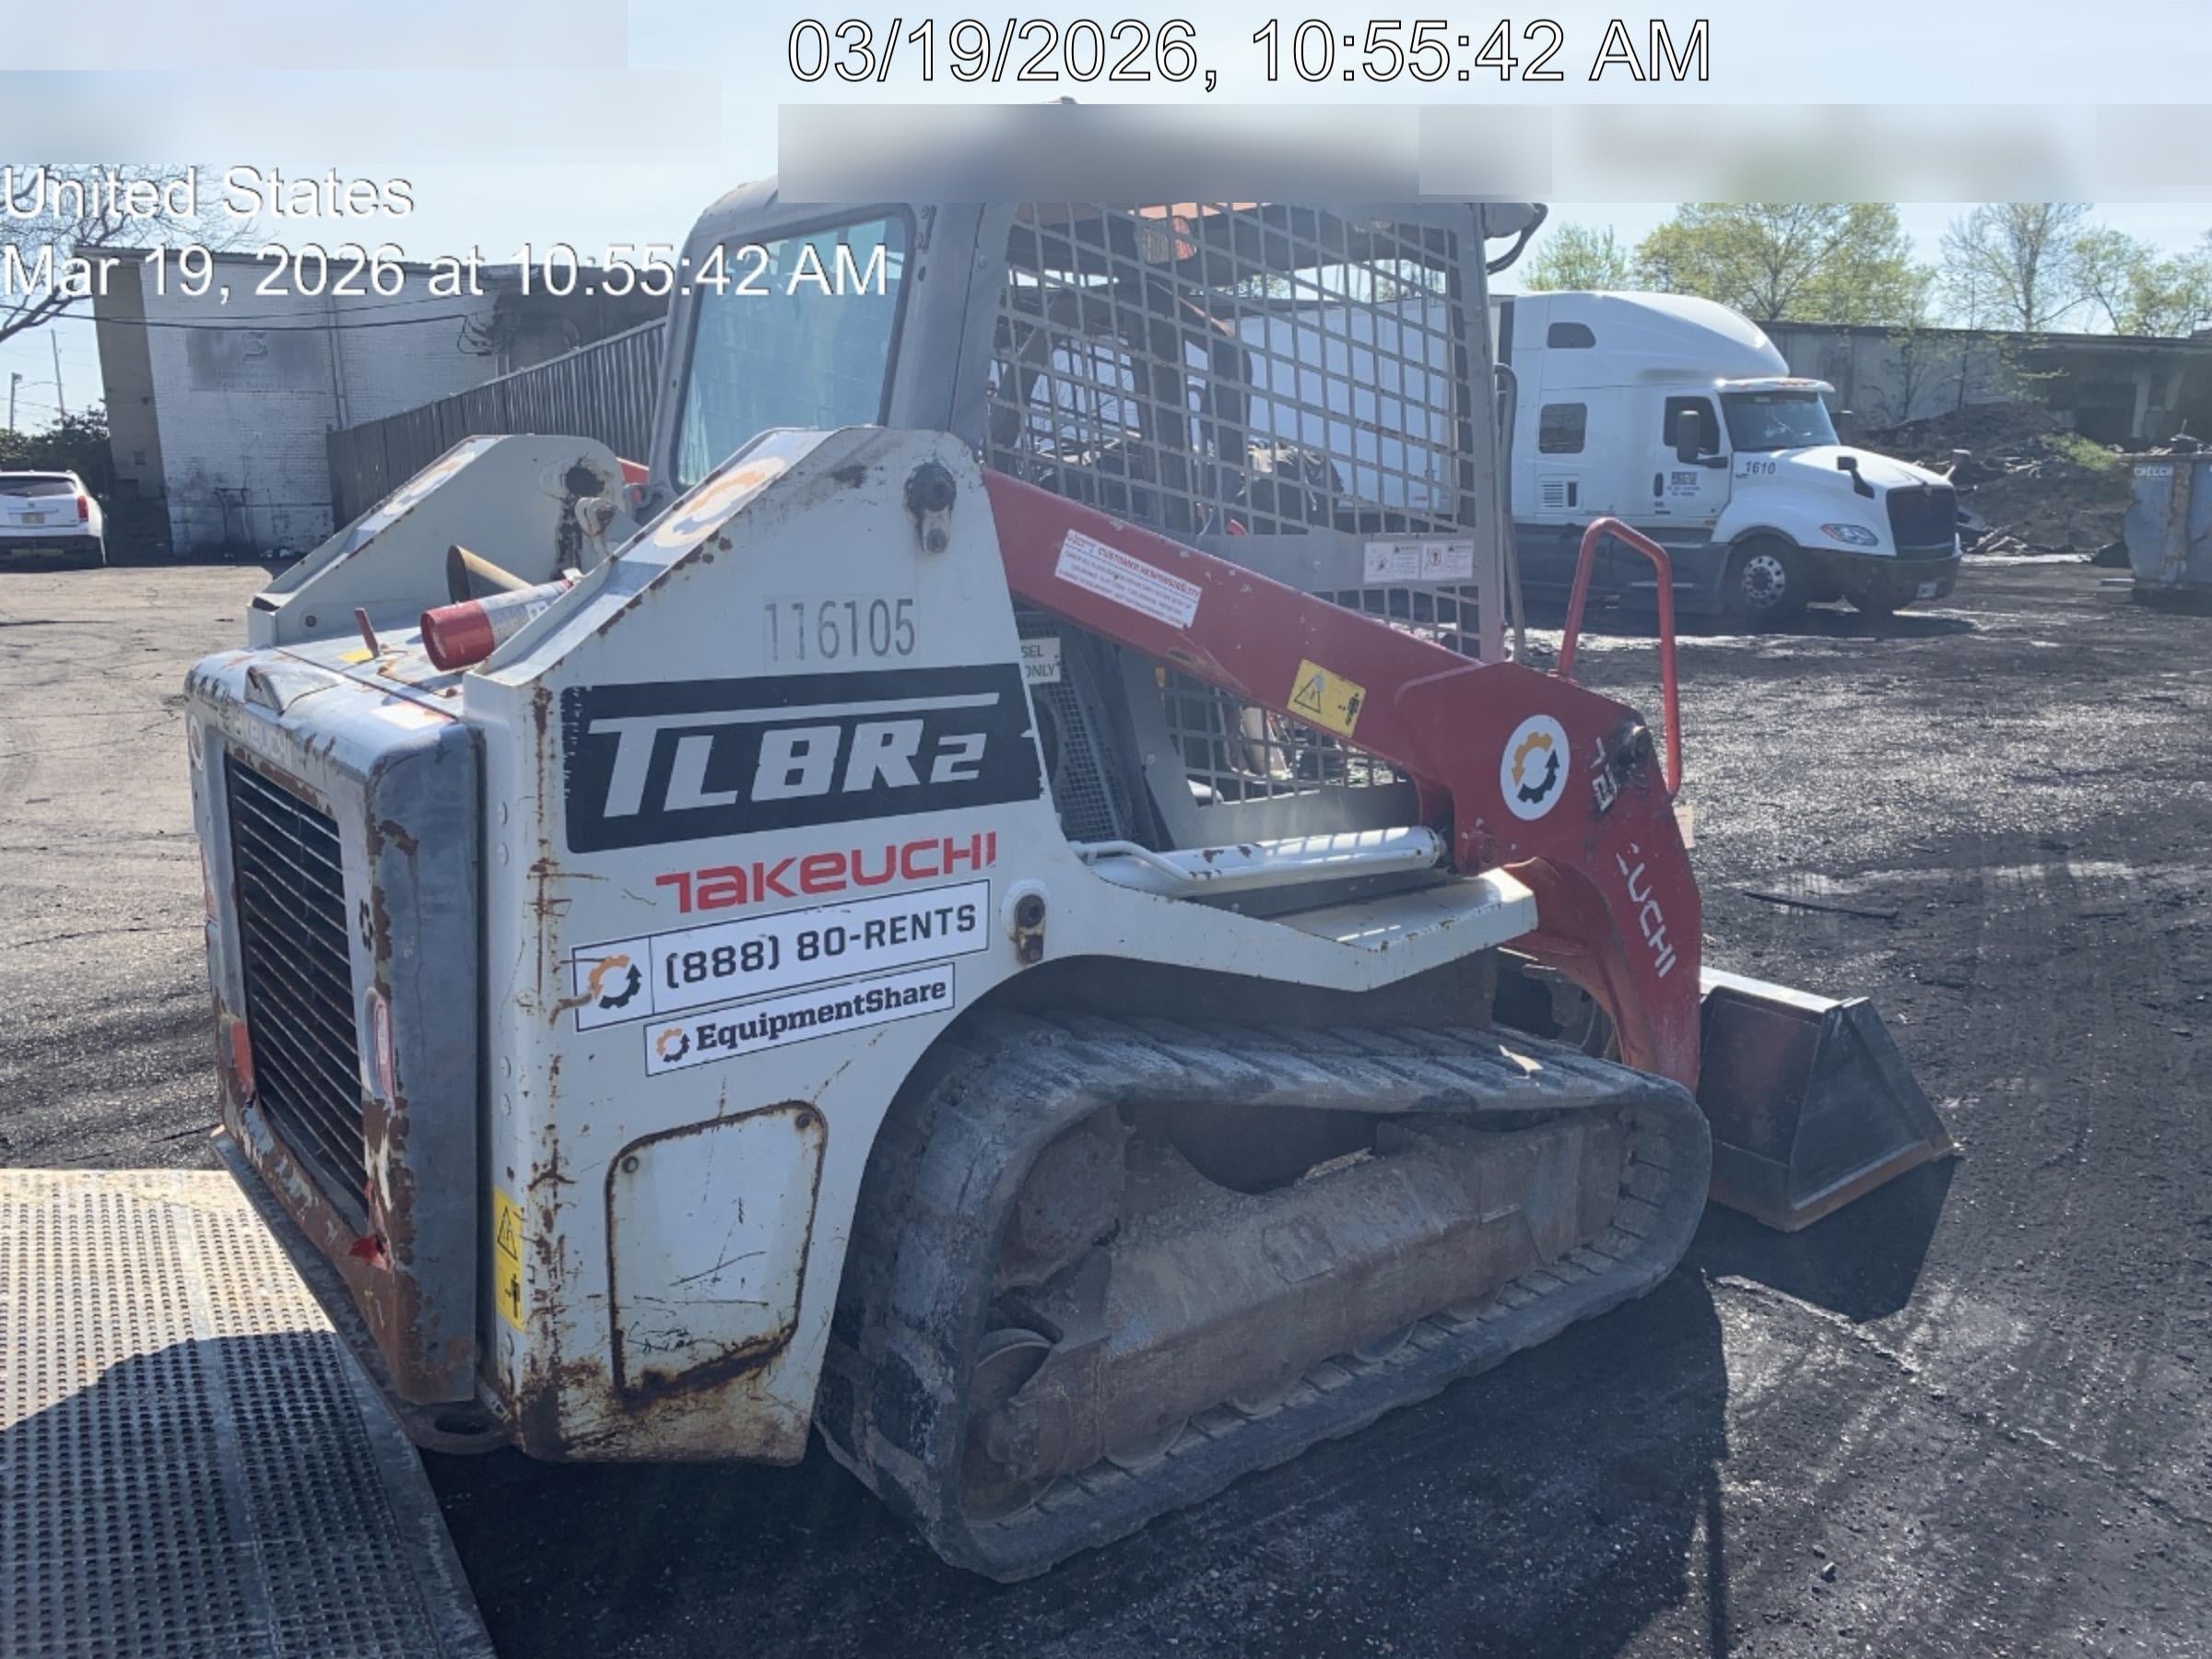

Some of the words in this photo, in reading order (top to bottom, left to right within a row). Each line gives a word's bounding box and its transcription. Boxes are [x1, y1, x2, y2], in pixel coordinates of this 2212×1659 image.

[1745, 461, 1776, 475] 1610
[763, 597, 917, 662] 116105
[655, 832, 996, 914] TAKEUCHI
[666, 940, 781, 990] (888)
[796, 904, 977, 962] 80-RENTS
[696, 978, 947, 1053] EquipmentShare
